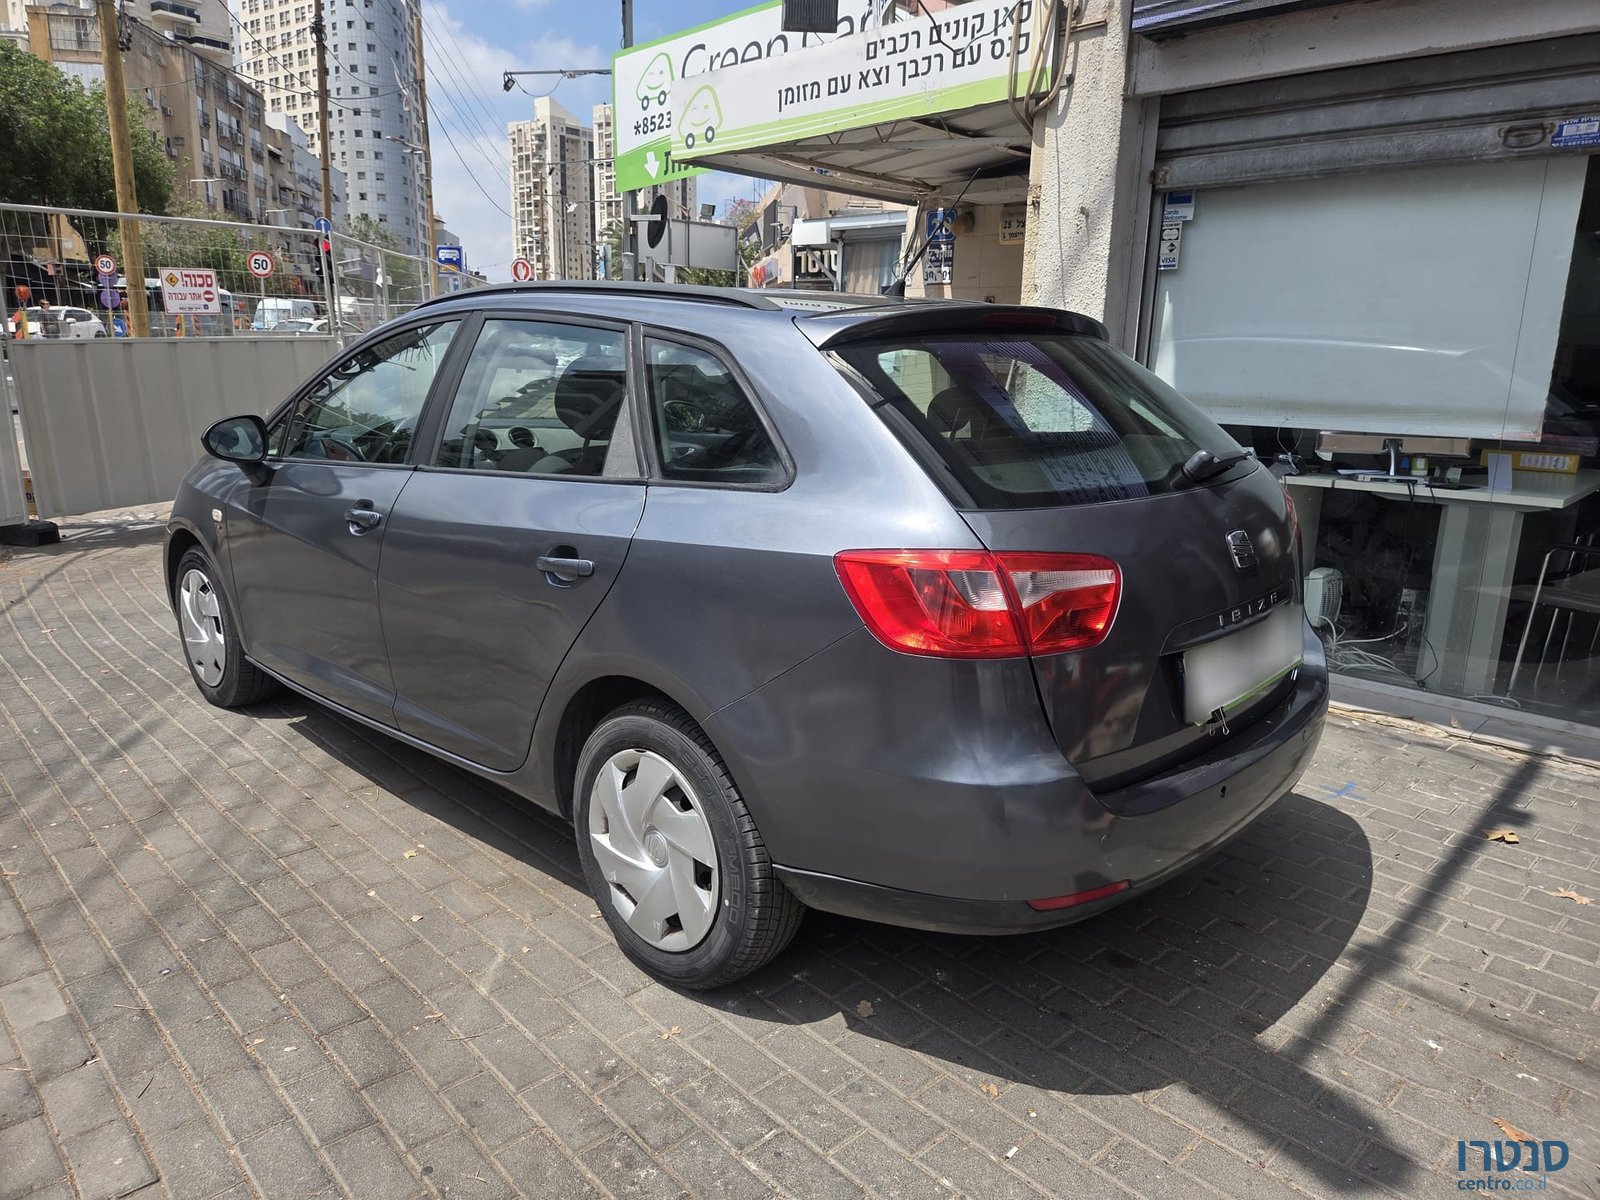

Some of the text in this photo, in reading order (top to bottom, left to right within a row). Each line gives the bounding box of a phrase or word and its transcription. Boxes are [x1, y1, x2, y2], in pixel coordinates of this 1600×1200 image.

[866, 1, 1033, 61] כאן קונים רכבים
[952, 43, 982, 70] עם
[858, 64, 890, 90] וצא
[897, 52, 944, 87] רכבך
[778, 80, 821, 113] מזומן
[827, 73, 851, 97] עם
[99, 260, 111, 270] 50
[253, 258, 268, 271] 50
[1161, 256, 1176, 264] VISA
[180, 271, 214, 288] סכנה!
[168, 292, 202, 301] אתר עבודה
